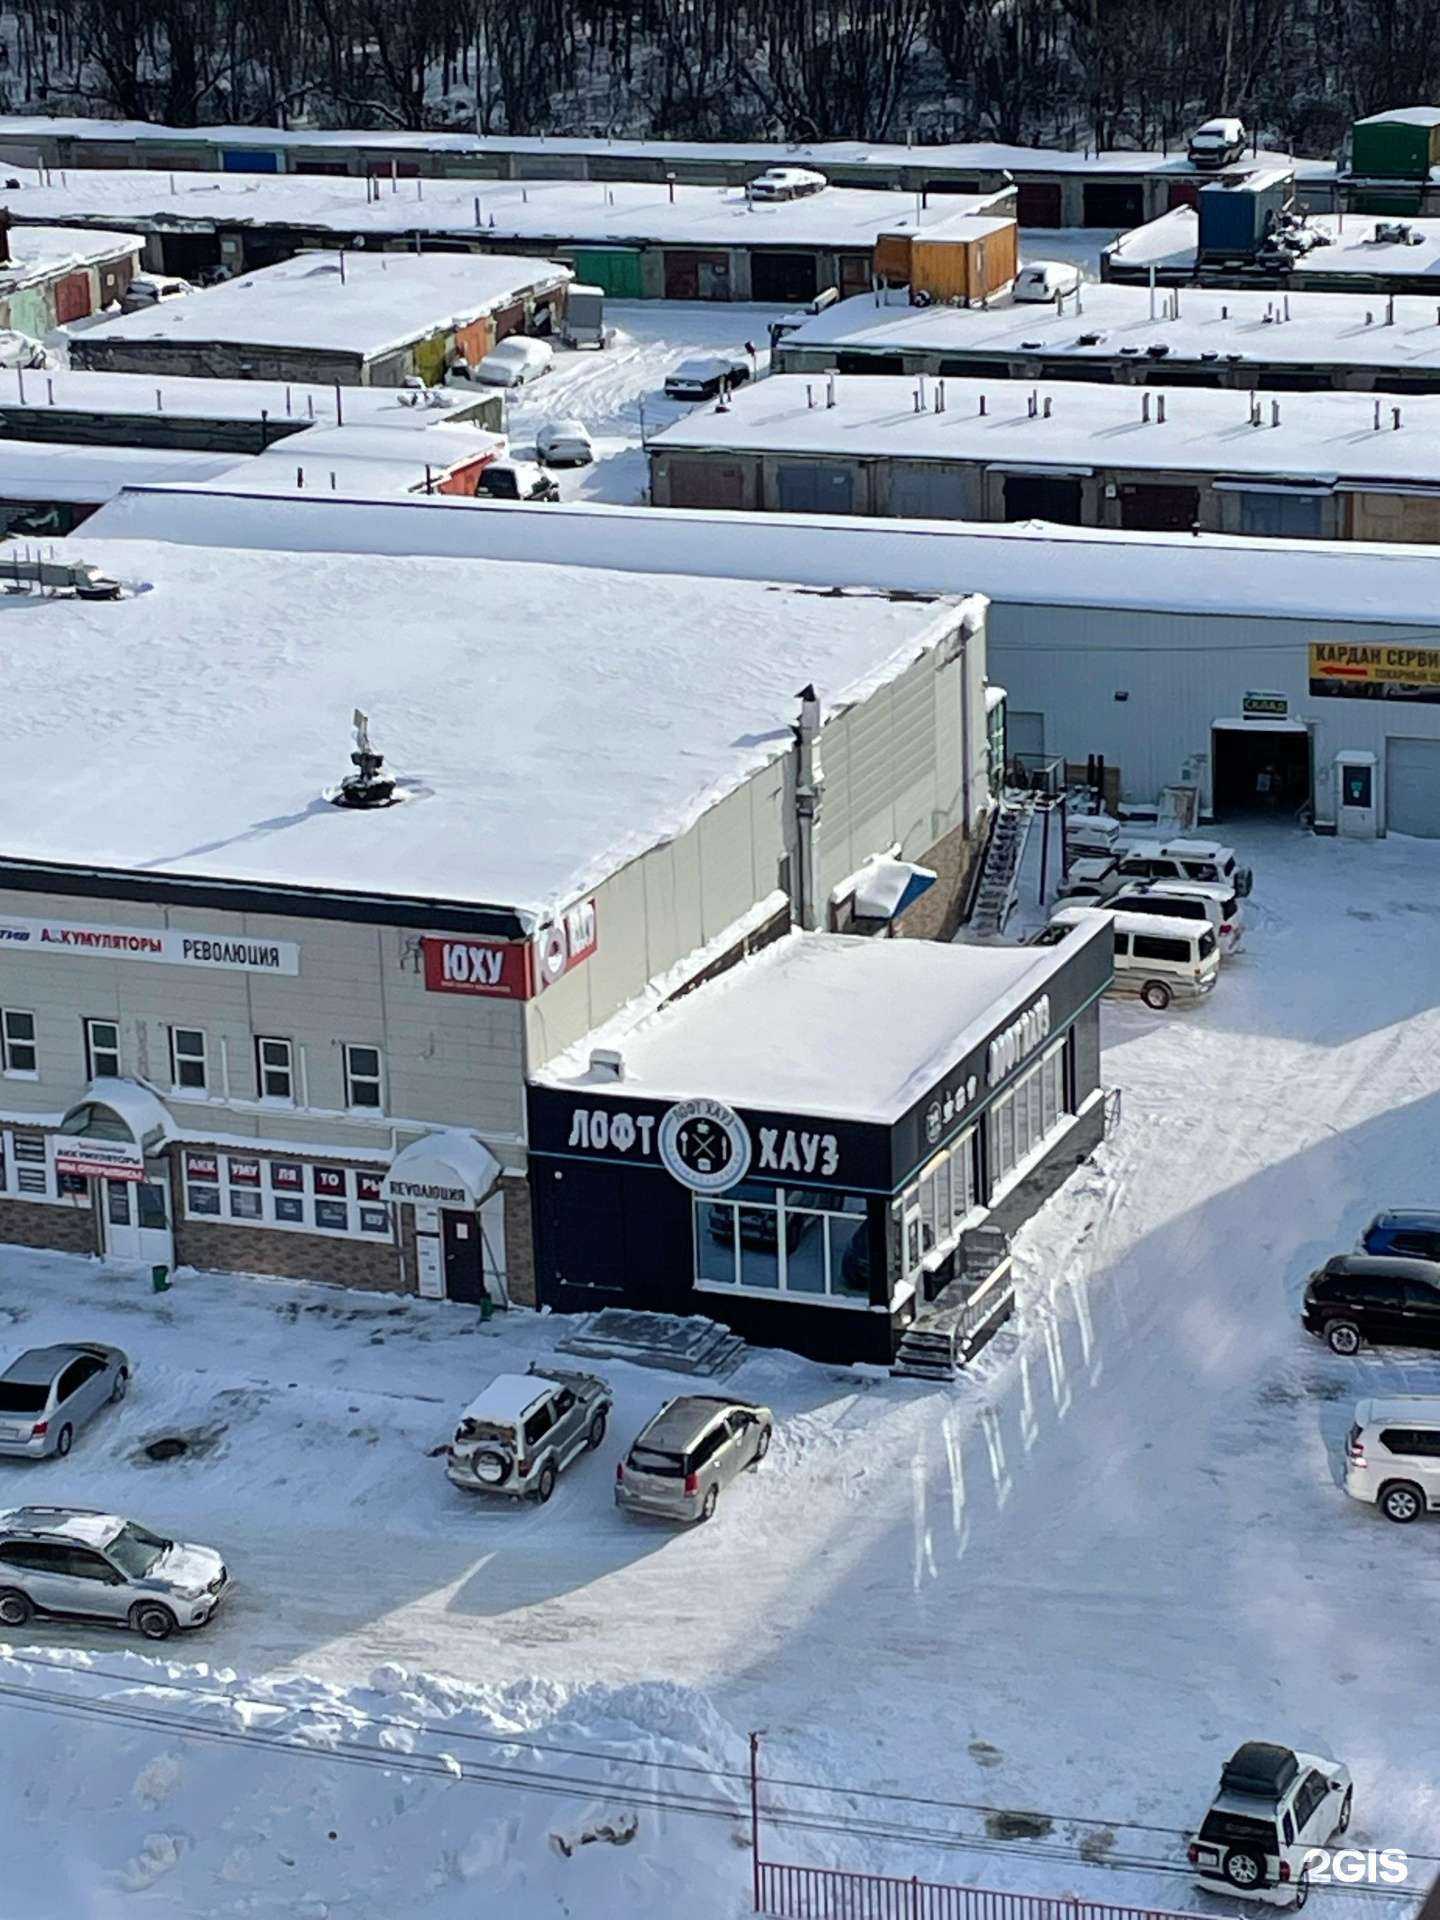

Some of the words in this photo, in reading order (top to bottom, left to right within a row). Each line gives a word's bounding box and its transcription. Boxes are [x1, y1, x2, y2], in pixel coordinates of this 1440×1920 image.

[1316, 643, 1381, 666] КАРДАН
[40, 928, 162, 953] АКУМУЛЯТОРЫ
[183, 939, 280, 968] РЕВОЛЮЦИЯ
[443, 944, 504, 985] ЮХУ
[568, 1109, 655, 1155] ЛОФТ
[758, 1127, 839, 1176] ХАУЗ
[320, 1173, 340, 1187] ТО
